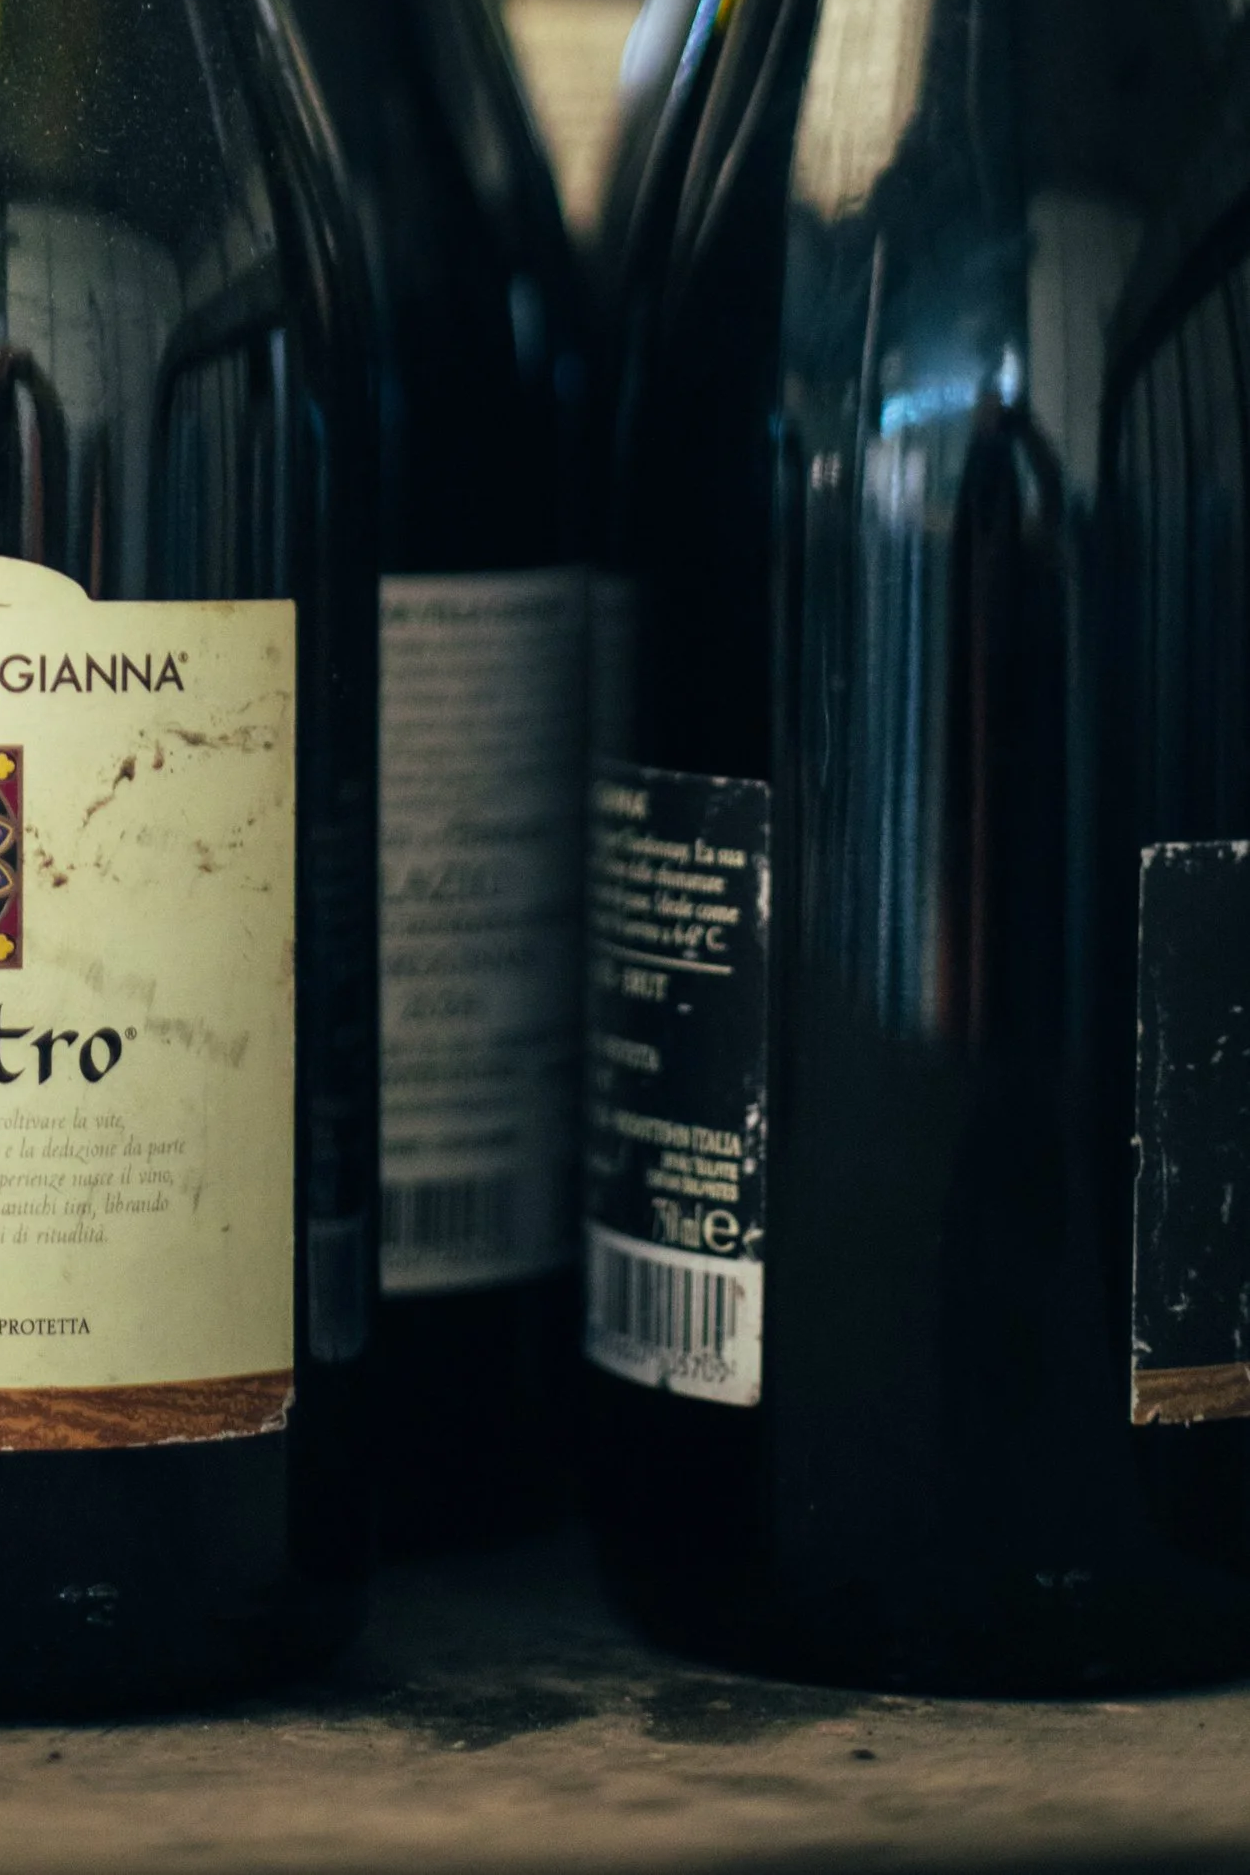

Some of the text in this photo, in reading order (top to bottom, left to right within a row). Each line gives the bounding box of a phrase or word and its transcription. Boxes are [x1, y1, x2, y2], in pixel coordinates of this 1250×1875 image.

[73, 1107, 87, 1130] la
[5, 1145, 13, 1160] e
[20, 1136, 34, 1159] la
[41, 1135, 118, 1164] dedizione
[123, 1134, 142, 1156] da
[147, 1138, 186, 1164] parte
[72, 1170, 113, 1189] nasce
[120, 1163, 131, 1185] il
[1, 1193, 56, 1218] antichi
[105, 1191, 169, 1215] librando
[12, 1223, 28, 1245] di
